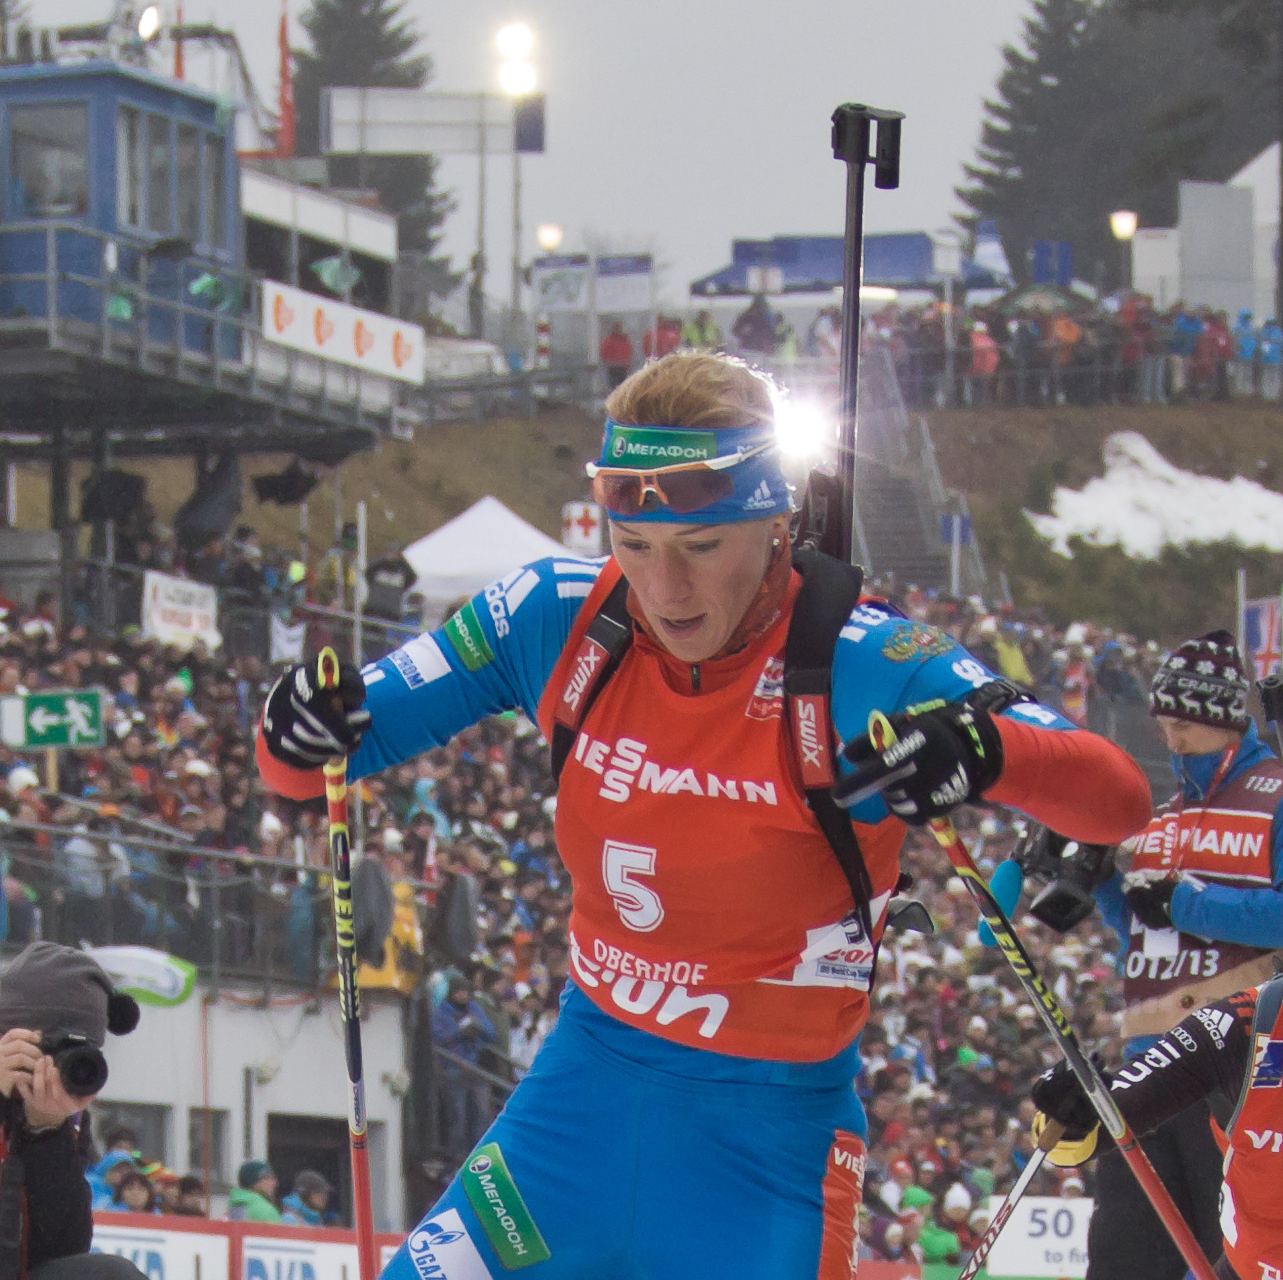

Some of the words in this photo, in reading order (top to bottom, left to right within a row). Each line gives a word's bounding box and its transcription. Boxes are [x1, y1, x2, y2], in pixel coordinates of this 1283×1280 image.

[574, 732, 778, 806] IESSMANN
[1134, 822, 1264, 865] IESSMANN
[602, 839, 665, 932] 5
[594, 939, 708, 986] OBERHOF
[1028, 1207, 1075, 1239] 50
